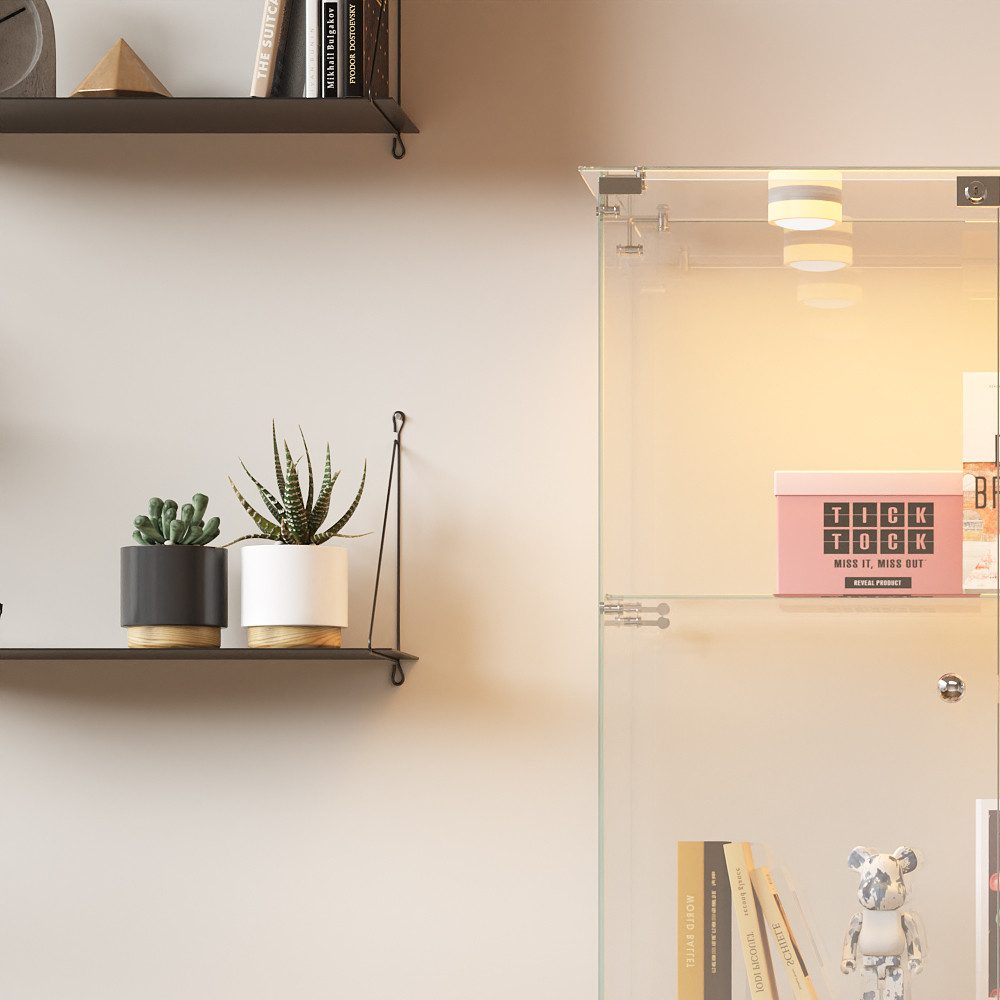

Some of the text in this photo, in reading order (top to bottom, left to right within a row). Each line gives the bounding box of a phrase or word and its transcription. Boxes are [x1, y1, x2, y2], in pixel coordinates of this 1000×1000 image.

[326, 7, 337, 89] Mikhail Bulgakov
[256, 52, 270, 80] THE
[831, 506, 927, 524] TICK
[831, 533, 927, 551] TOCK
[834, 559, 859, 569] MISS
[862, 559, 874, 570] IT,
[877, 559, 902, 569] MISS
[853, 579, 902, 587] REVEAL PRODUCT
